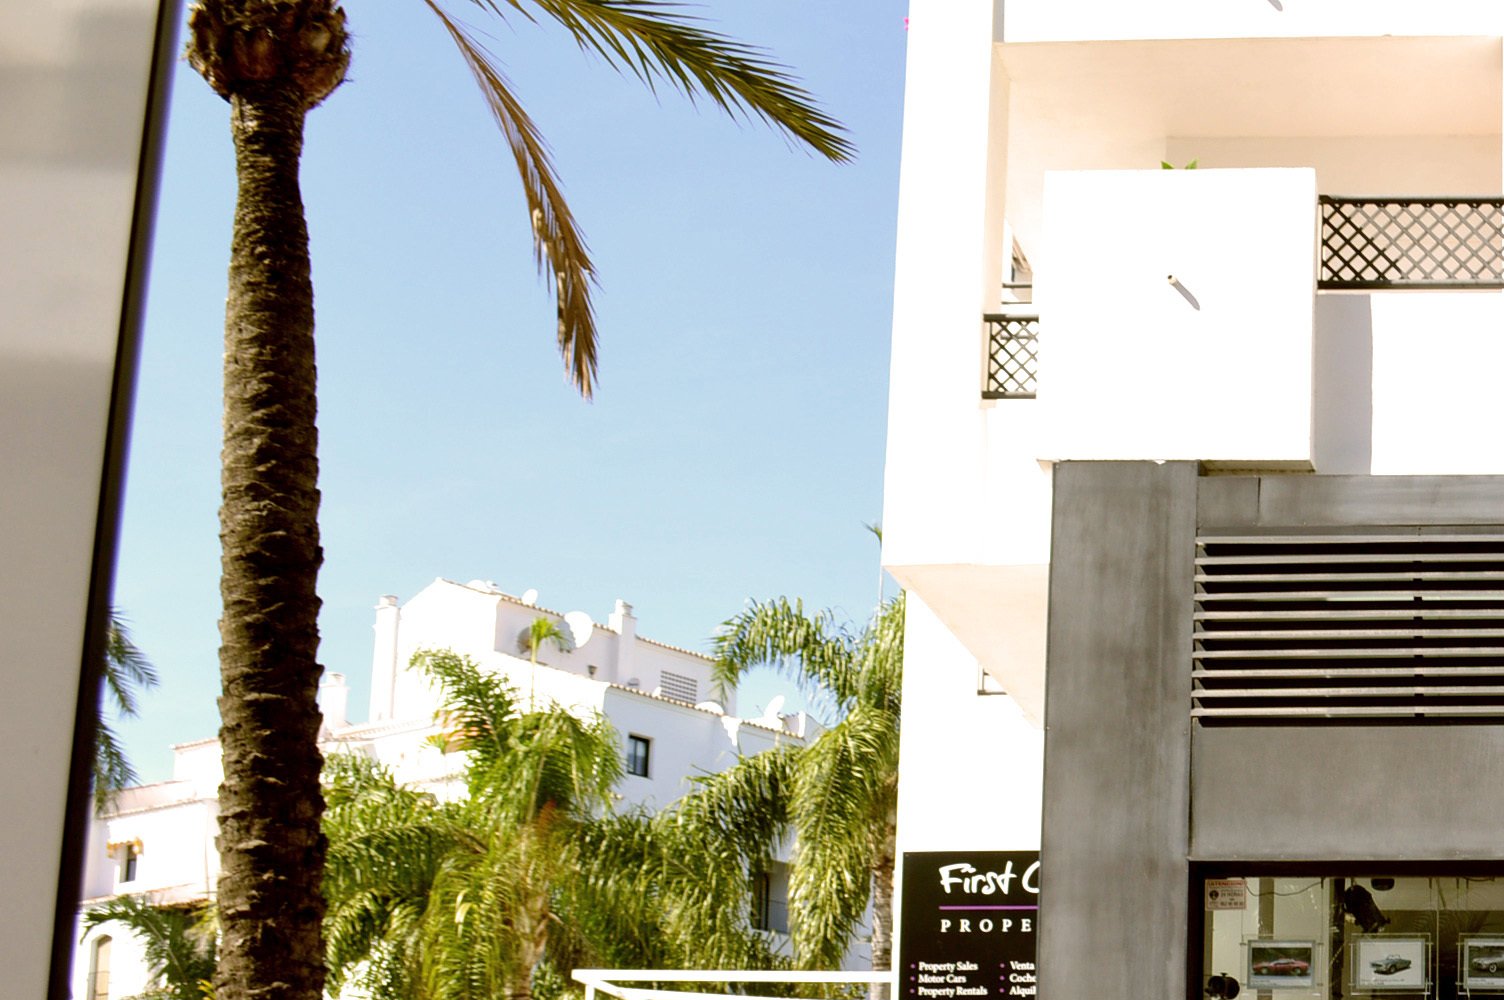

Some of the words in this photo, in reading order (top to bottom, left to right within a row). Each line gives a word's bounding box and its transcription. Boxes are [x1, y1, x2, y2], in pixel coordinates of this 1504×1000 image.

[938, 860, 1017, 895] First
[940, 918, 1032, 933] PROPE
[918, 962, 955, 973] Property
[956, 962, 979, 971] Sales
[1009, 961, 1035, 971] Venta
[918, 974, 945, 983] Motor
[946, 974, 967, 983] Cars
[918, 986, 955, 998] Property
[956, 986, 988, 995] Rentals
